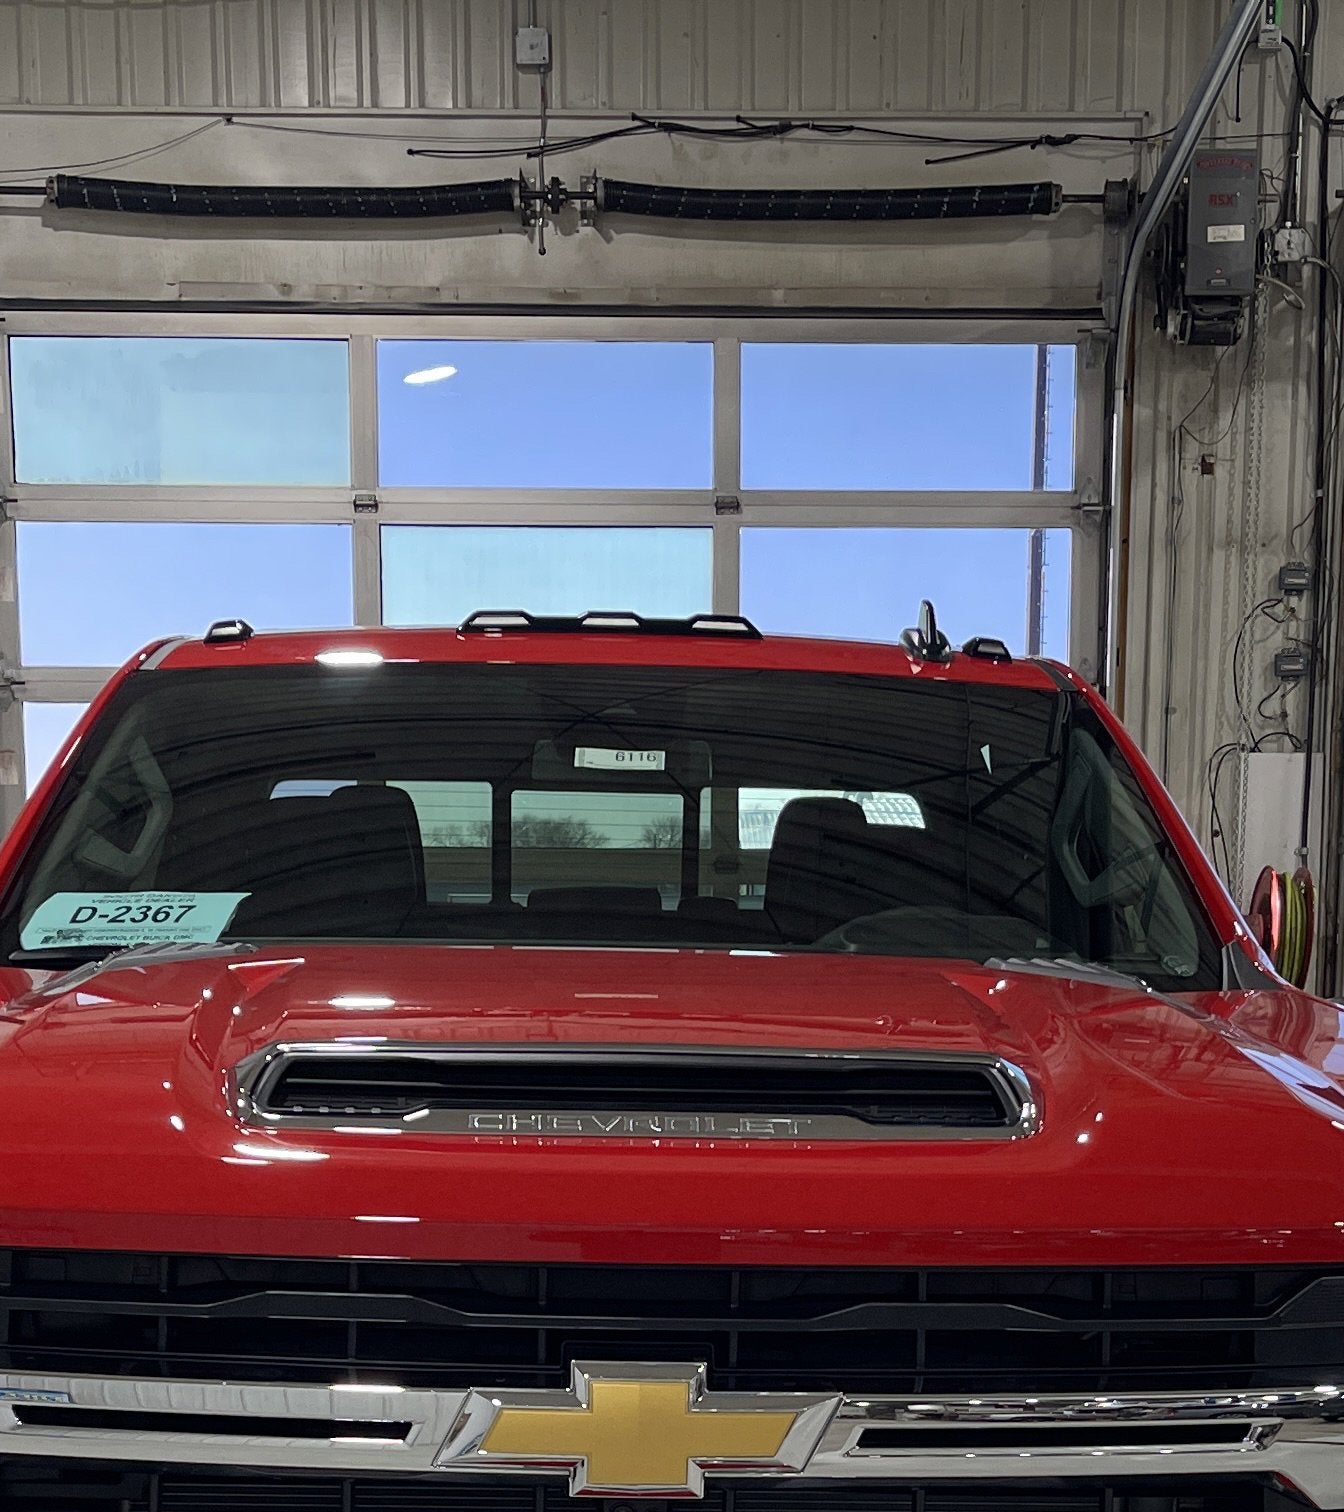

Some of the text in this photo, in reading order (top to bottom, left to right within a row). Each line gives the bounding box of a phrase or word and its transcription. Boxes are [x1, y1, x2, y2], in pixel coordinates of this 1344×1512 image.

[615, 751, 657, 762] 6116
[69, 905, 197, 924] D-2367
[467, 1113, 813, 1136] CHEVROLET
